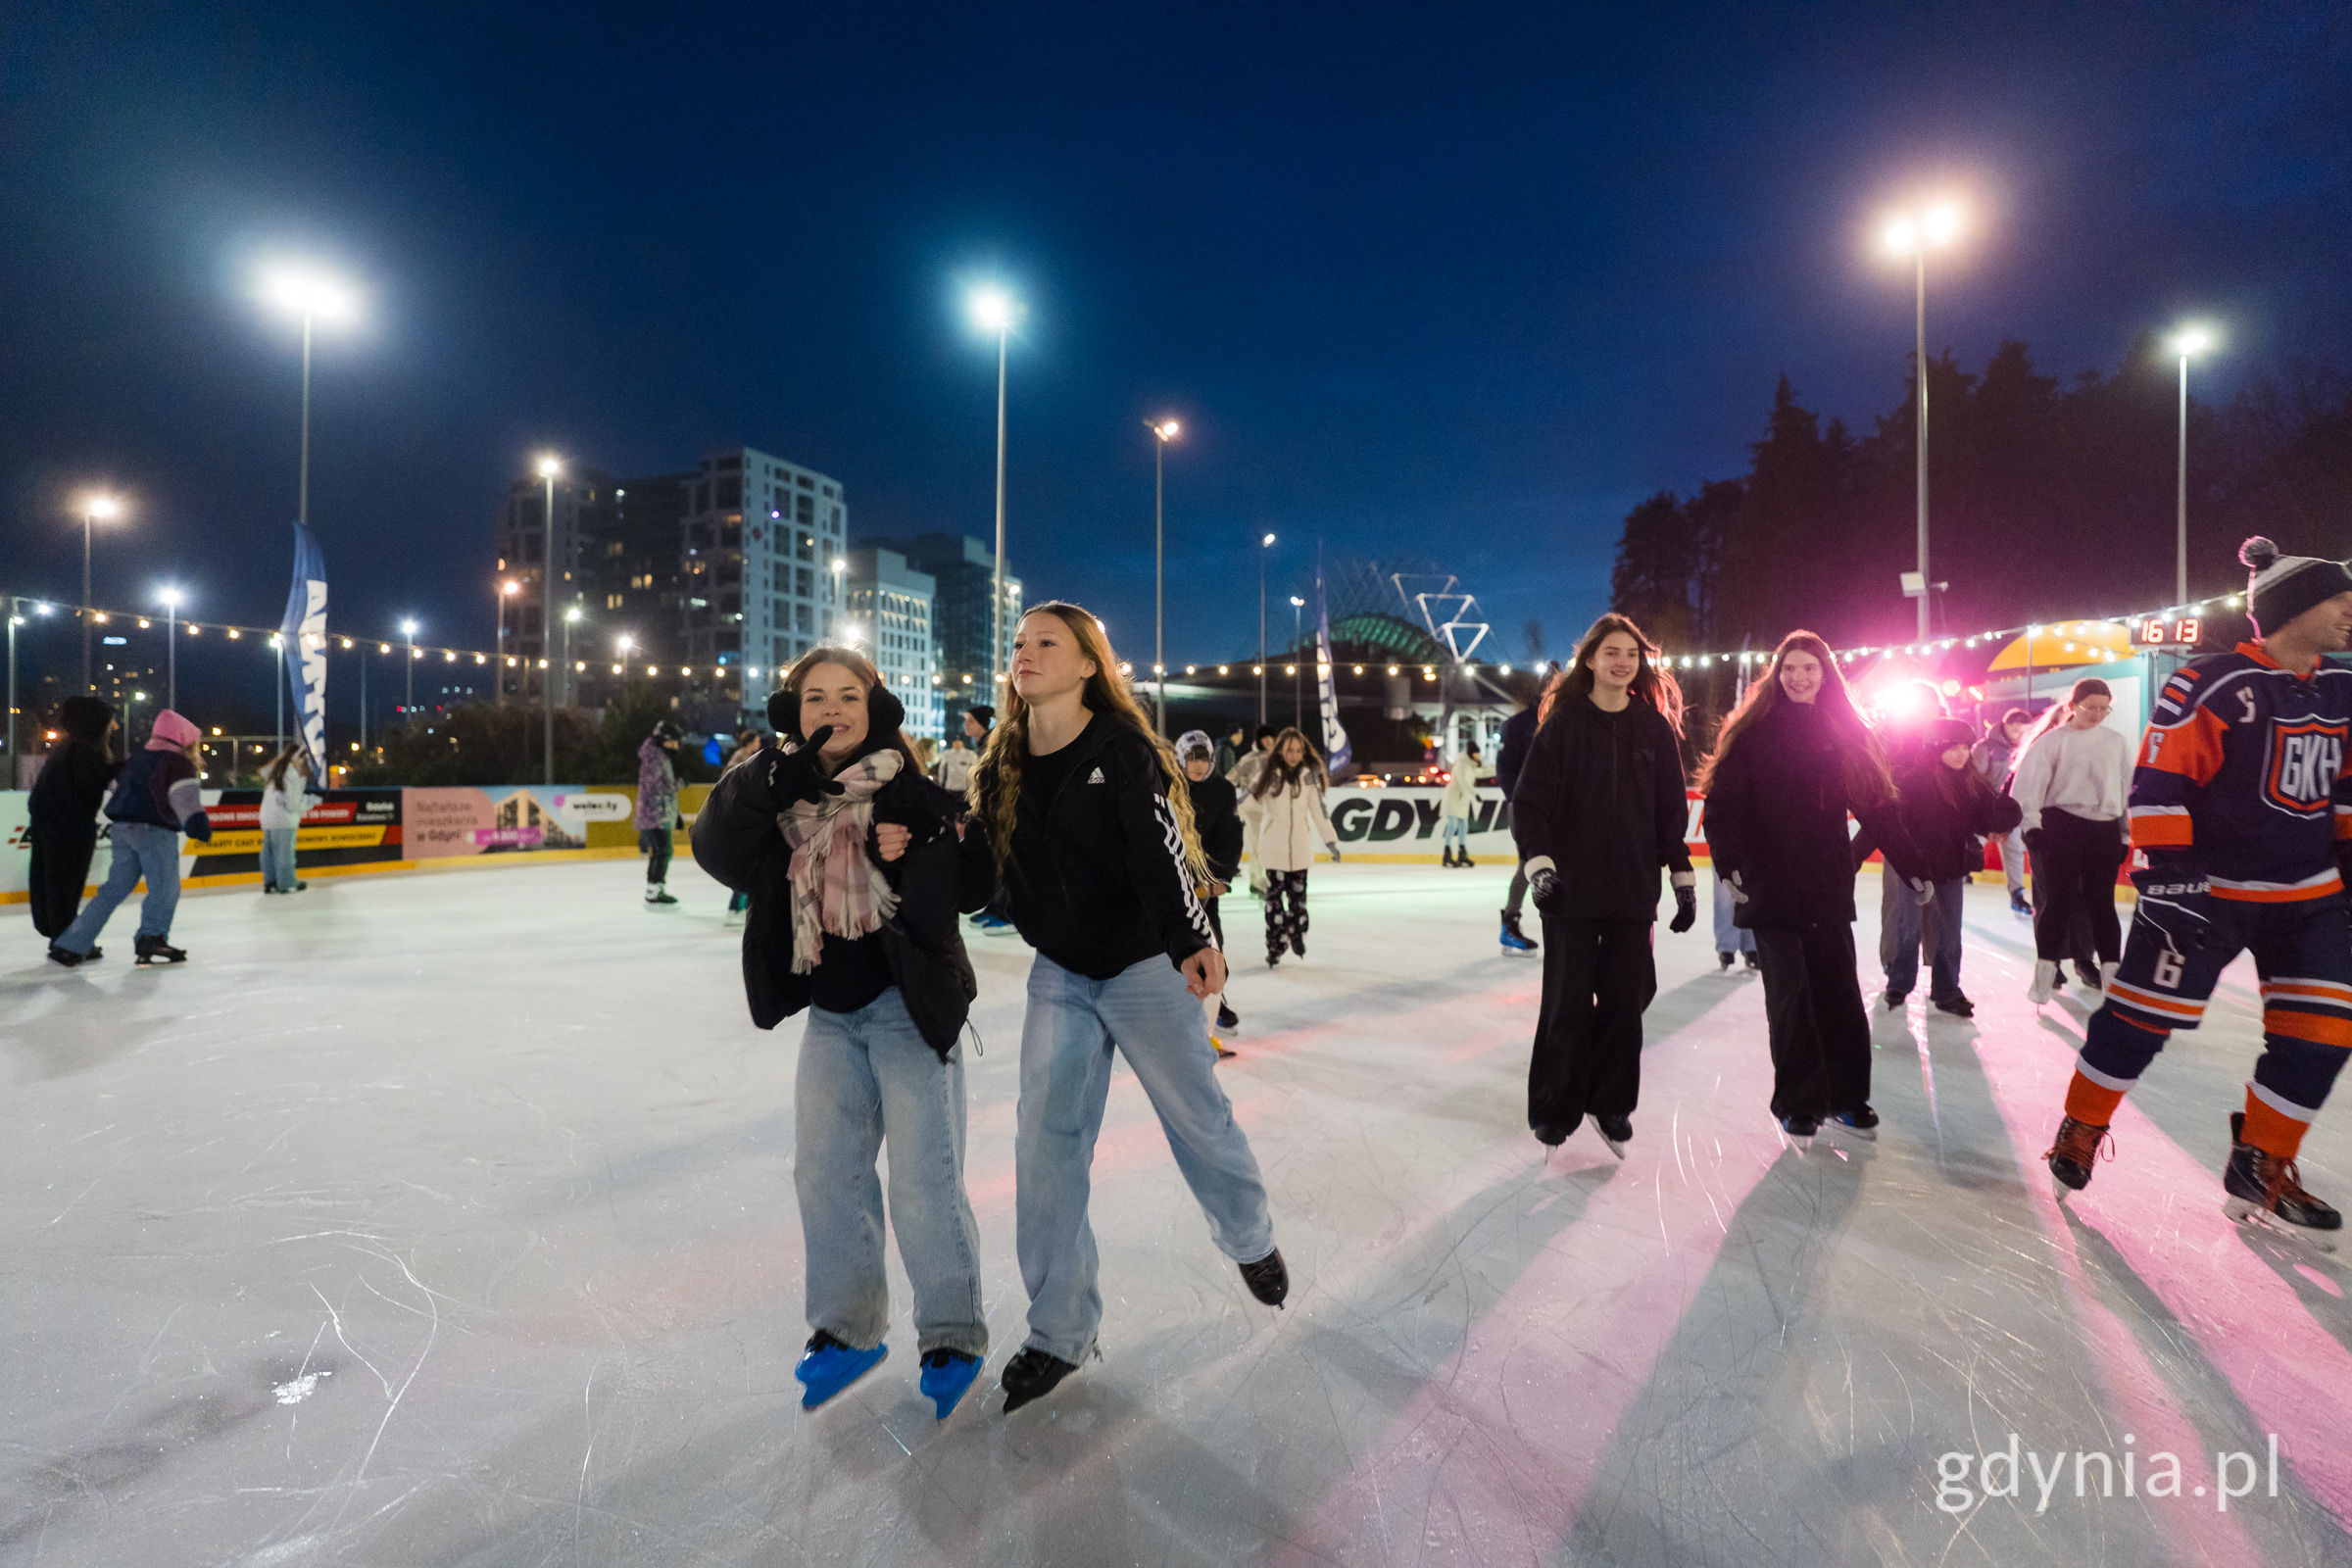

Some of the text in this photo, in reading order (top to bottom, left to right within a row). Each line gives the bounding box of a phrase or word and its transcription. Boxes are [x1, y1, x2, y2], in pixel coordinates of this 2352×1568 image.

[2141, 618, 2199, 643] 16 13
[2279, 734, 2343, 802] GKH
[2153, 949, 2186, 989] 6
